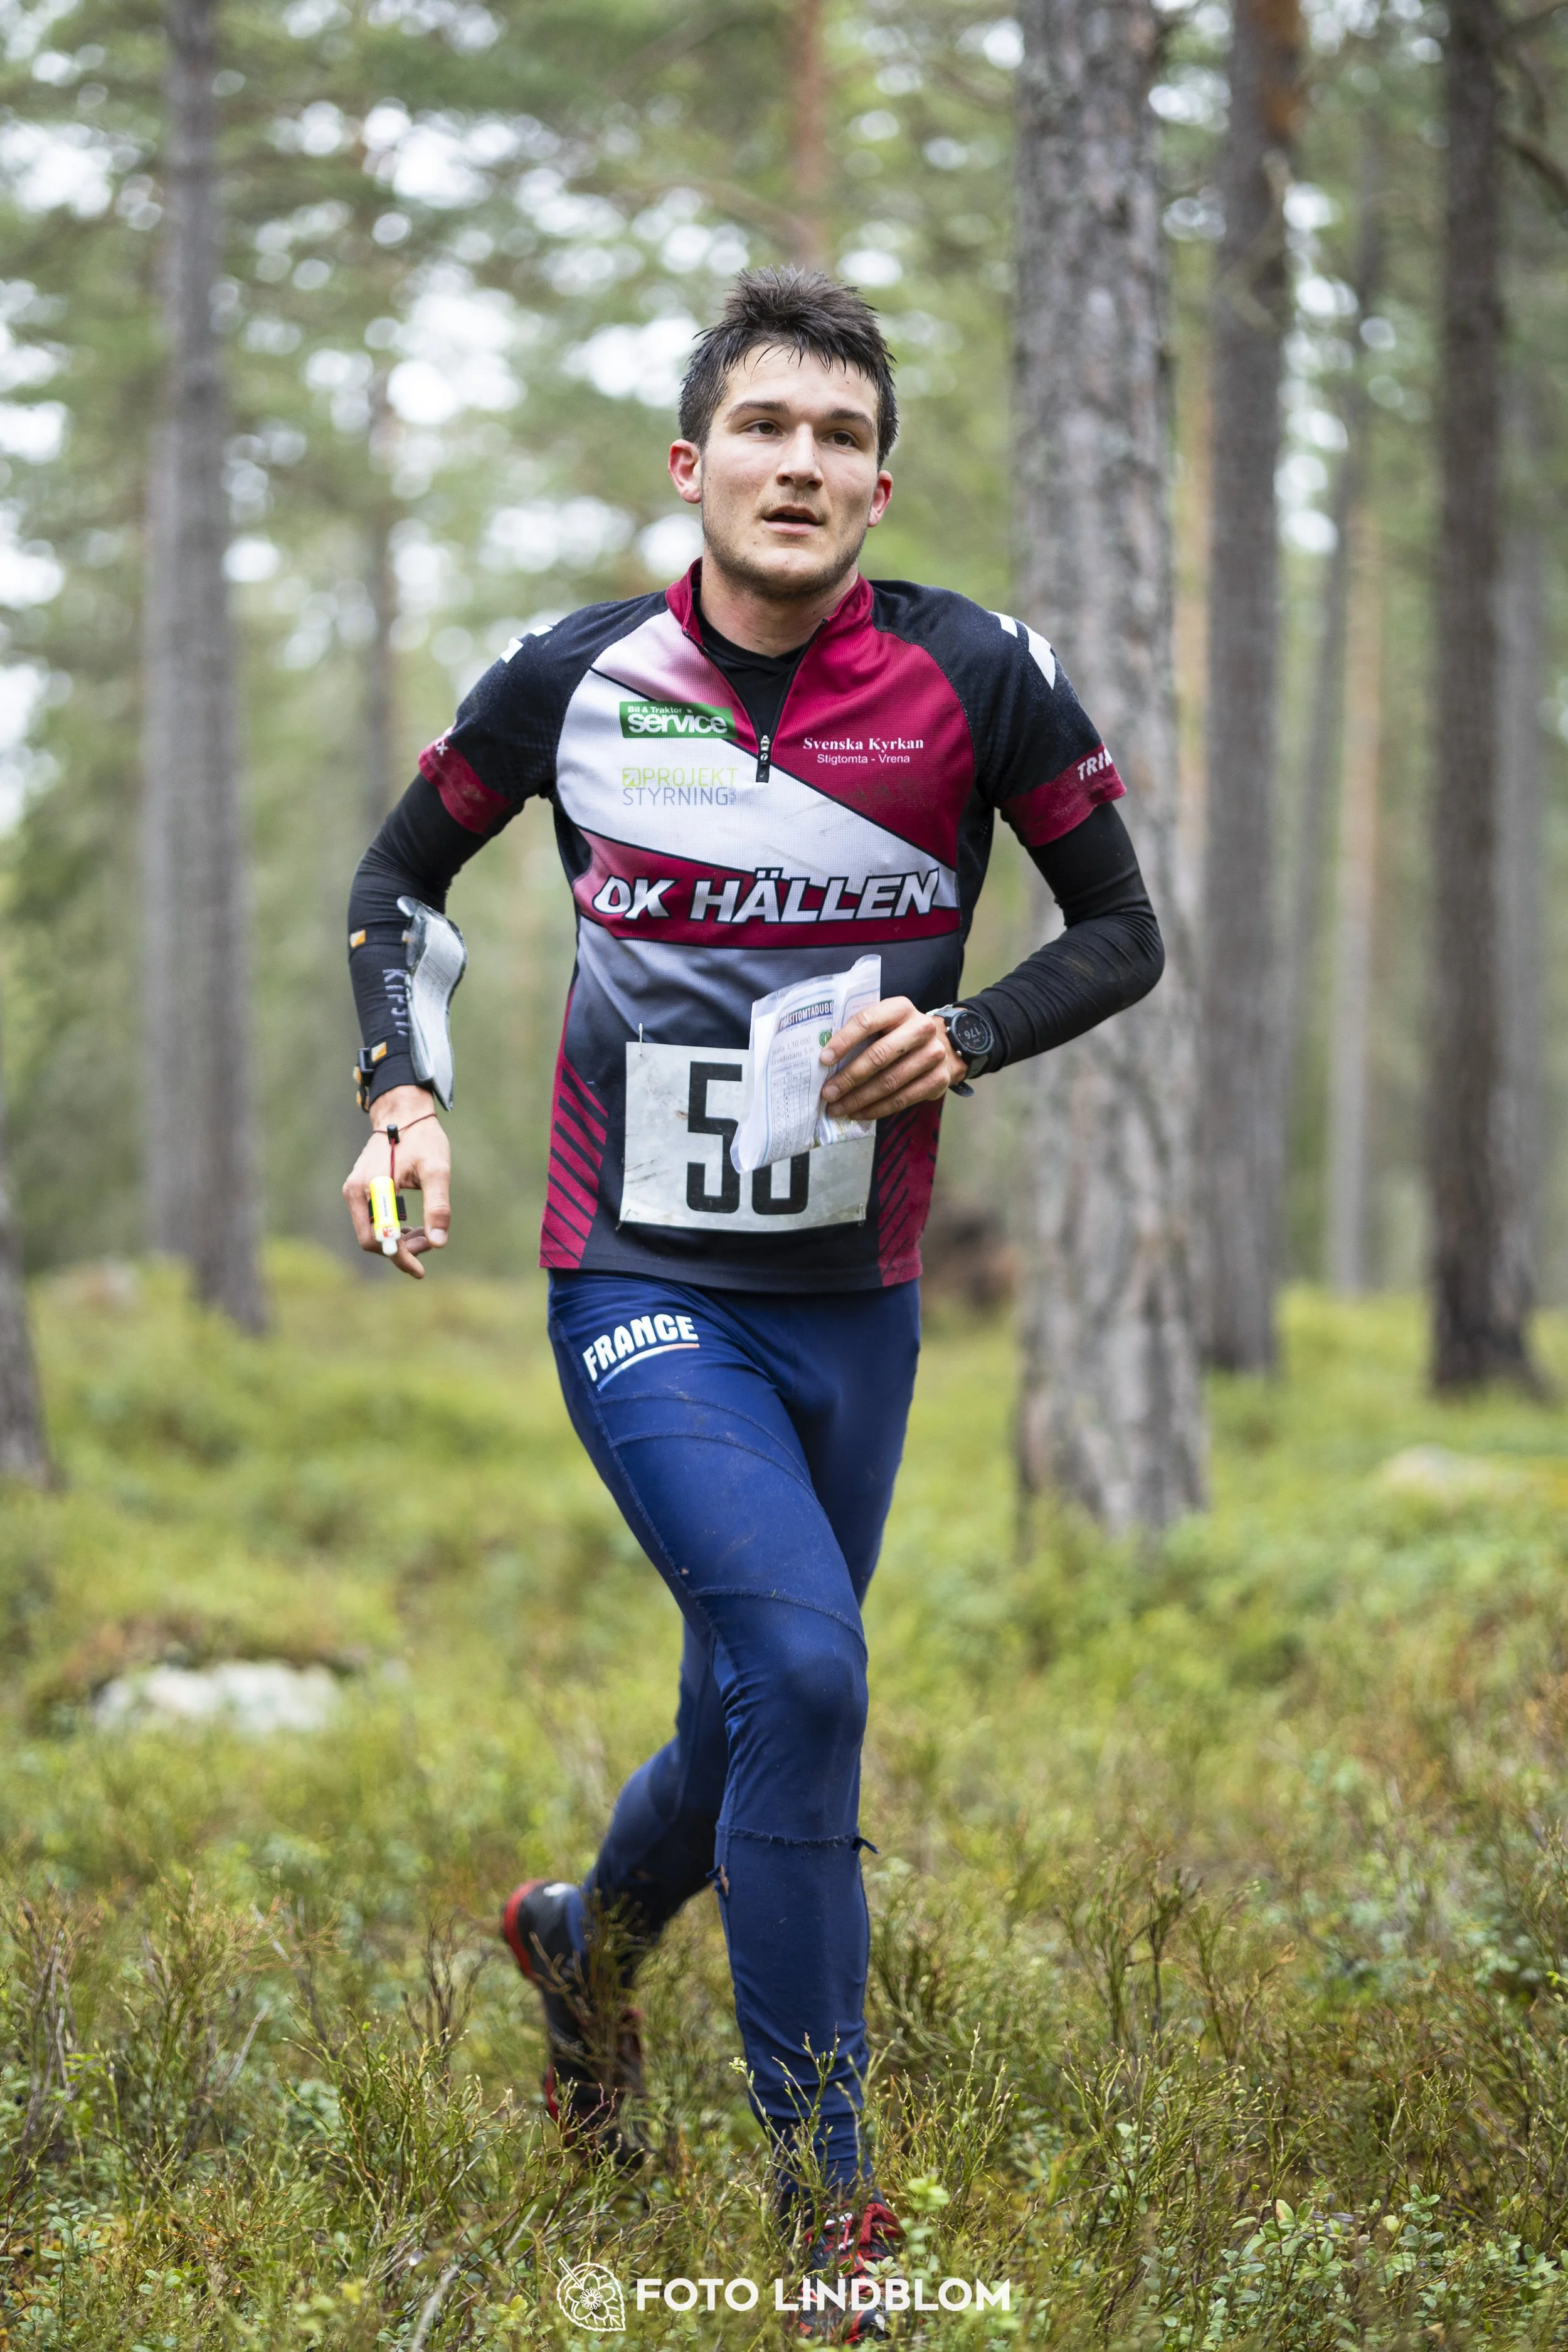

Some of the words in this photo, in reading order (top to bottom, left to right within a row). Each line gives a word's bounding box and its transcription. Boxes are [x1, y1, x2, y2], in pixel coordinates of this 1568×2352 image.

[627, 709, 728, 734] service
[803, 737, 863, 750] Svenska
[869, 737, 924, 753] Kyrkan
[817, 754, 868, 765] Stigtomta
[878, 754, 910, 763] Vrena
[642, 767, 738, 787] PROJEKT
[623, 787, 728, 806] STYRNING
[592, 876, 678, 920] OK
[688, 868, 939, 923] HÄLLEN
[964, 1027, 980, 1039] 176
[582, 1313, 699, 1382] FRANCE
